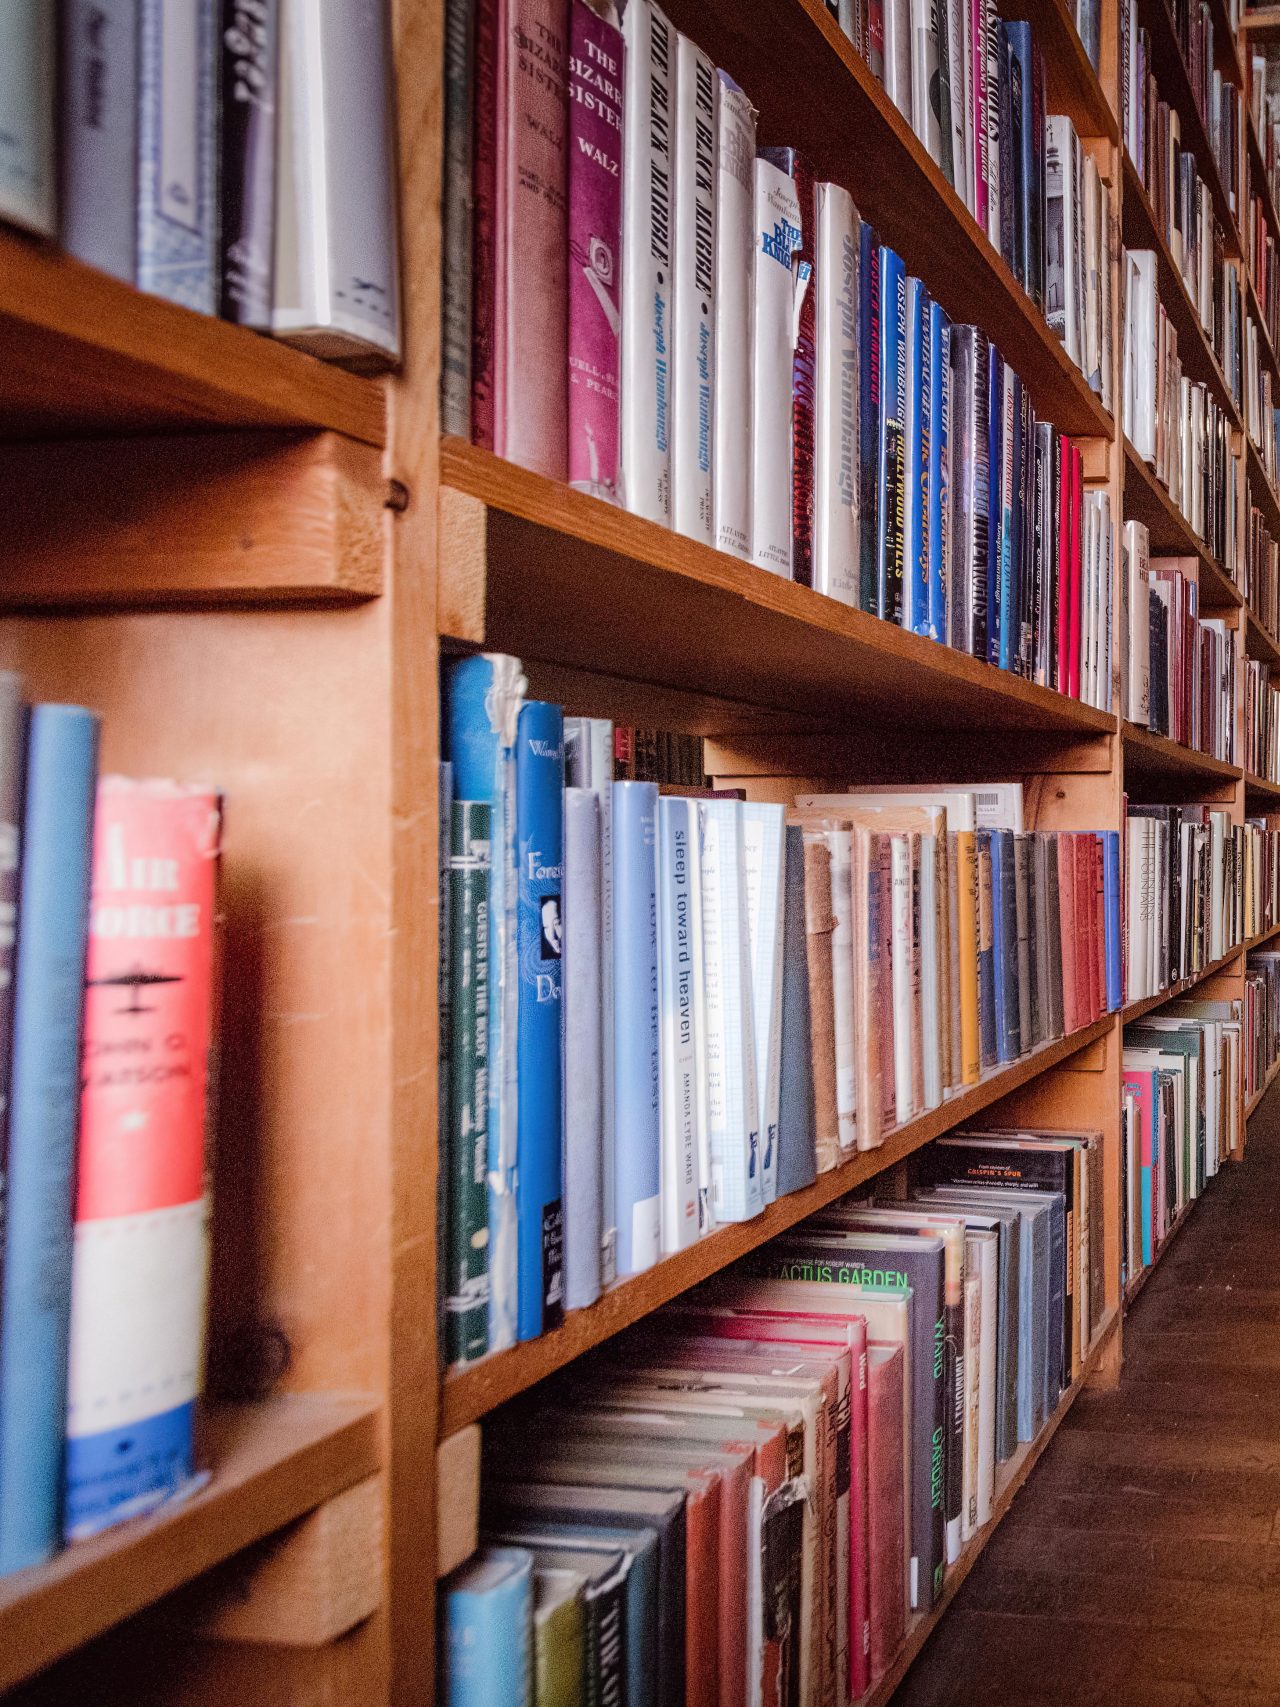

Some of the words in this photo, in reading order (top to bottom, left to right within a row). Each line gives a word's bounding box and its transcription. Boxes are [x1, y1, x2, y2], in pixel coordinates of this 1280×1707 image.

[583, 38, 617, 77] THE
[651, 13, 669, 77] THE
[651, 73, 669, 160] BLACK
[695, 58, 712, 121] THE
[577, 136, 619, 177] WALZ
[696, 117, 712, 197] BLACK
[651, 159, 669, 267] MARBLE
[696, 197, 712, 298] MARBLE
[836, 234, 857, 340] Joseph
[896, 273, 906, 334] JOSEPH
[653, 291, 666, 355] Joseph
[697, 321, 710, 381] Joseph
[896, 337, 906, 430] WAMBAUGH
[836, 346, 856, 510] Wambaugh
[895, 432, 905, 529] HOLLYWOOD
[895, 531, 904, 579] HILLS
[674, 829, 686, 884] sleep
[678, 892, 690, 963] toward
[476, 961, 488, 980] IN
[476, 983, 488, 1014] THE
[679, 969, 692, 1045] heaven
[682, 1072, 691, 1118] AMANDA
[684, 1120, 692, 1149] EYRE
[685, 1152, 694, 1185] WARD
[838, 1268, 909, 1288] GARDEN
[858, 1352, 867, 1391] Ward
[933, 1316, 944, 1379] WARD
[931, 1426, 944, 1510] GARDEN
